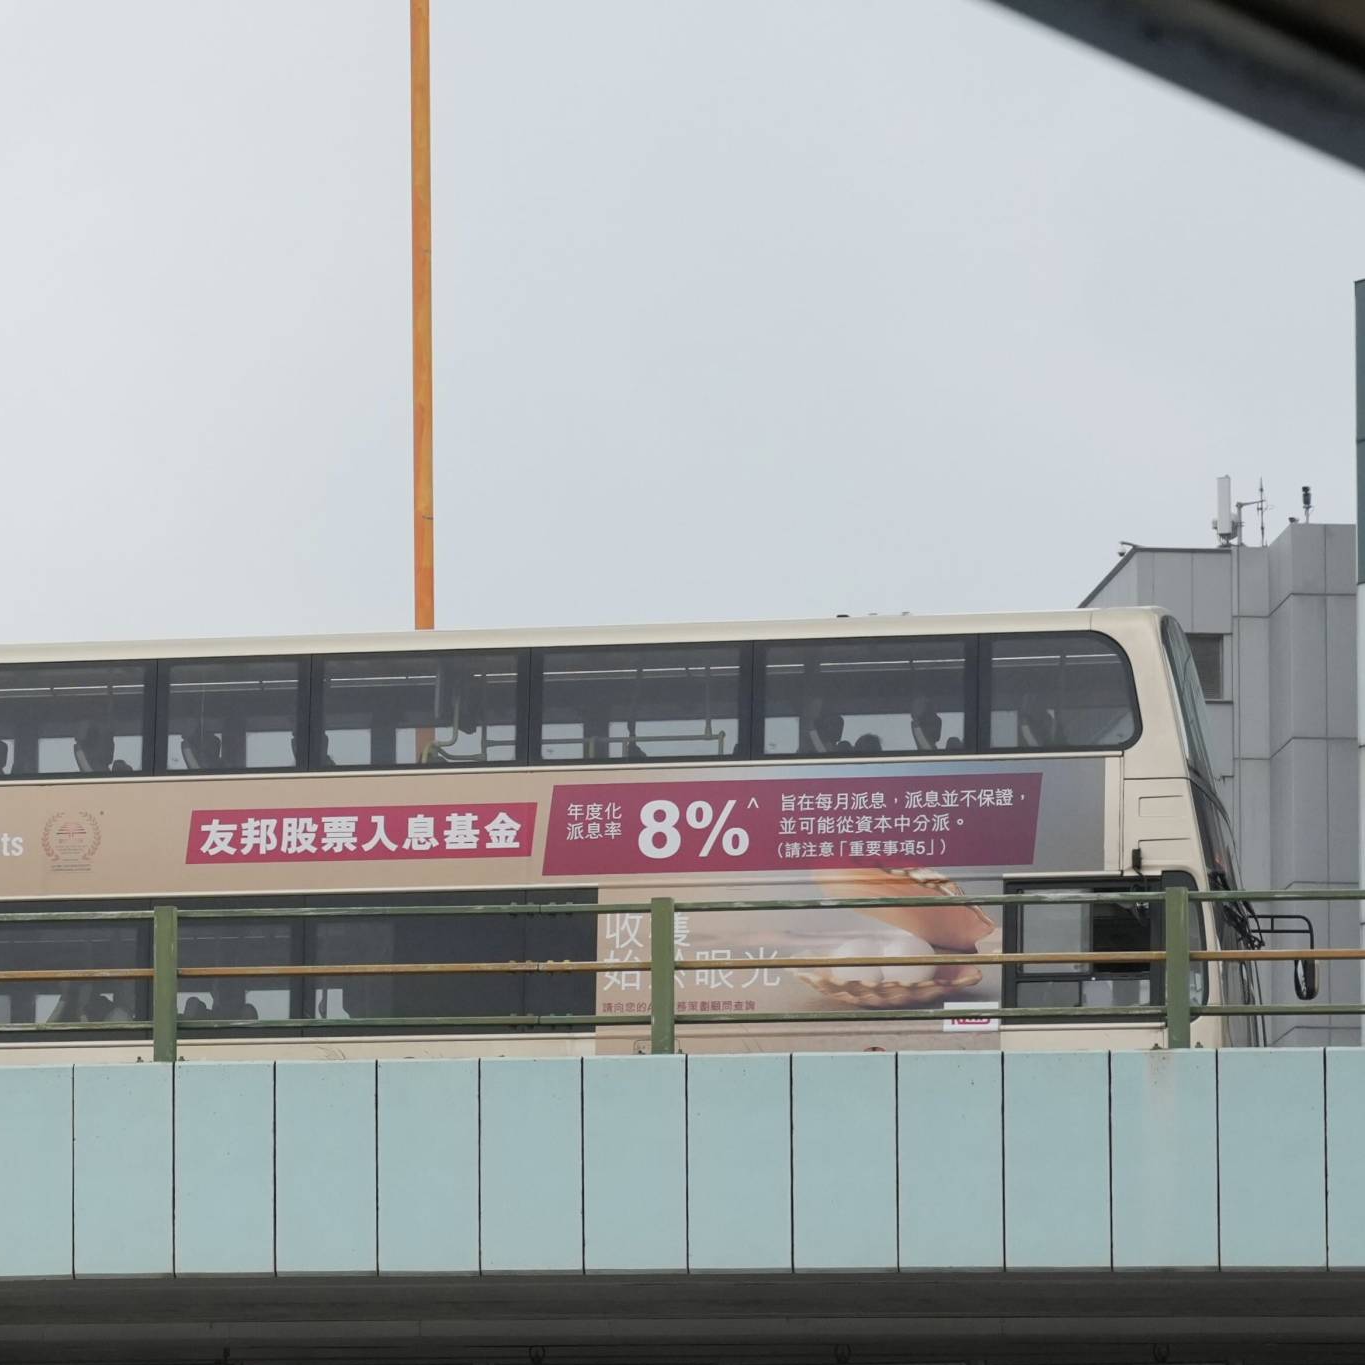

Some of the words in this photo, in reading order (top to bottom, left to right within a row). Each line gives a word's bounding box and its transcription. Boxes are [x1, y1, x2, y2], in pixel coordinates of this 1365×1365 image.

[567, 802, 622, 821] 年度化
[200, 812, 522, 856] 友邦股票入息基金
[566, 821, 622, 841] 派息率
[778, 814, 965, 835] 並可能從資本中分派。
